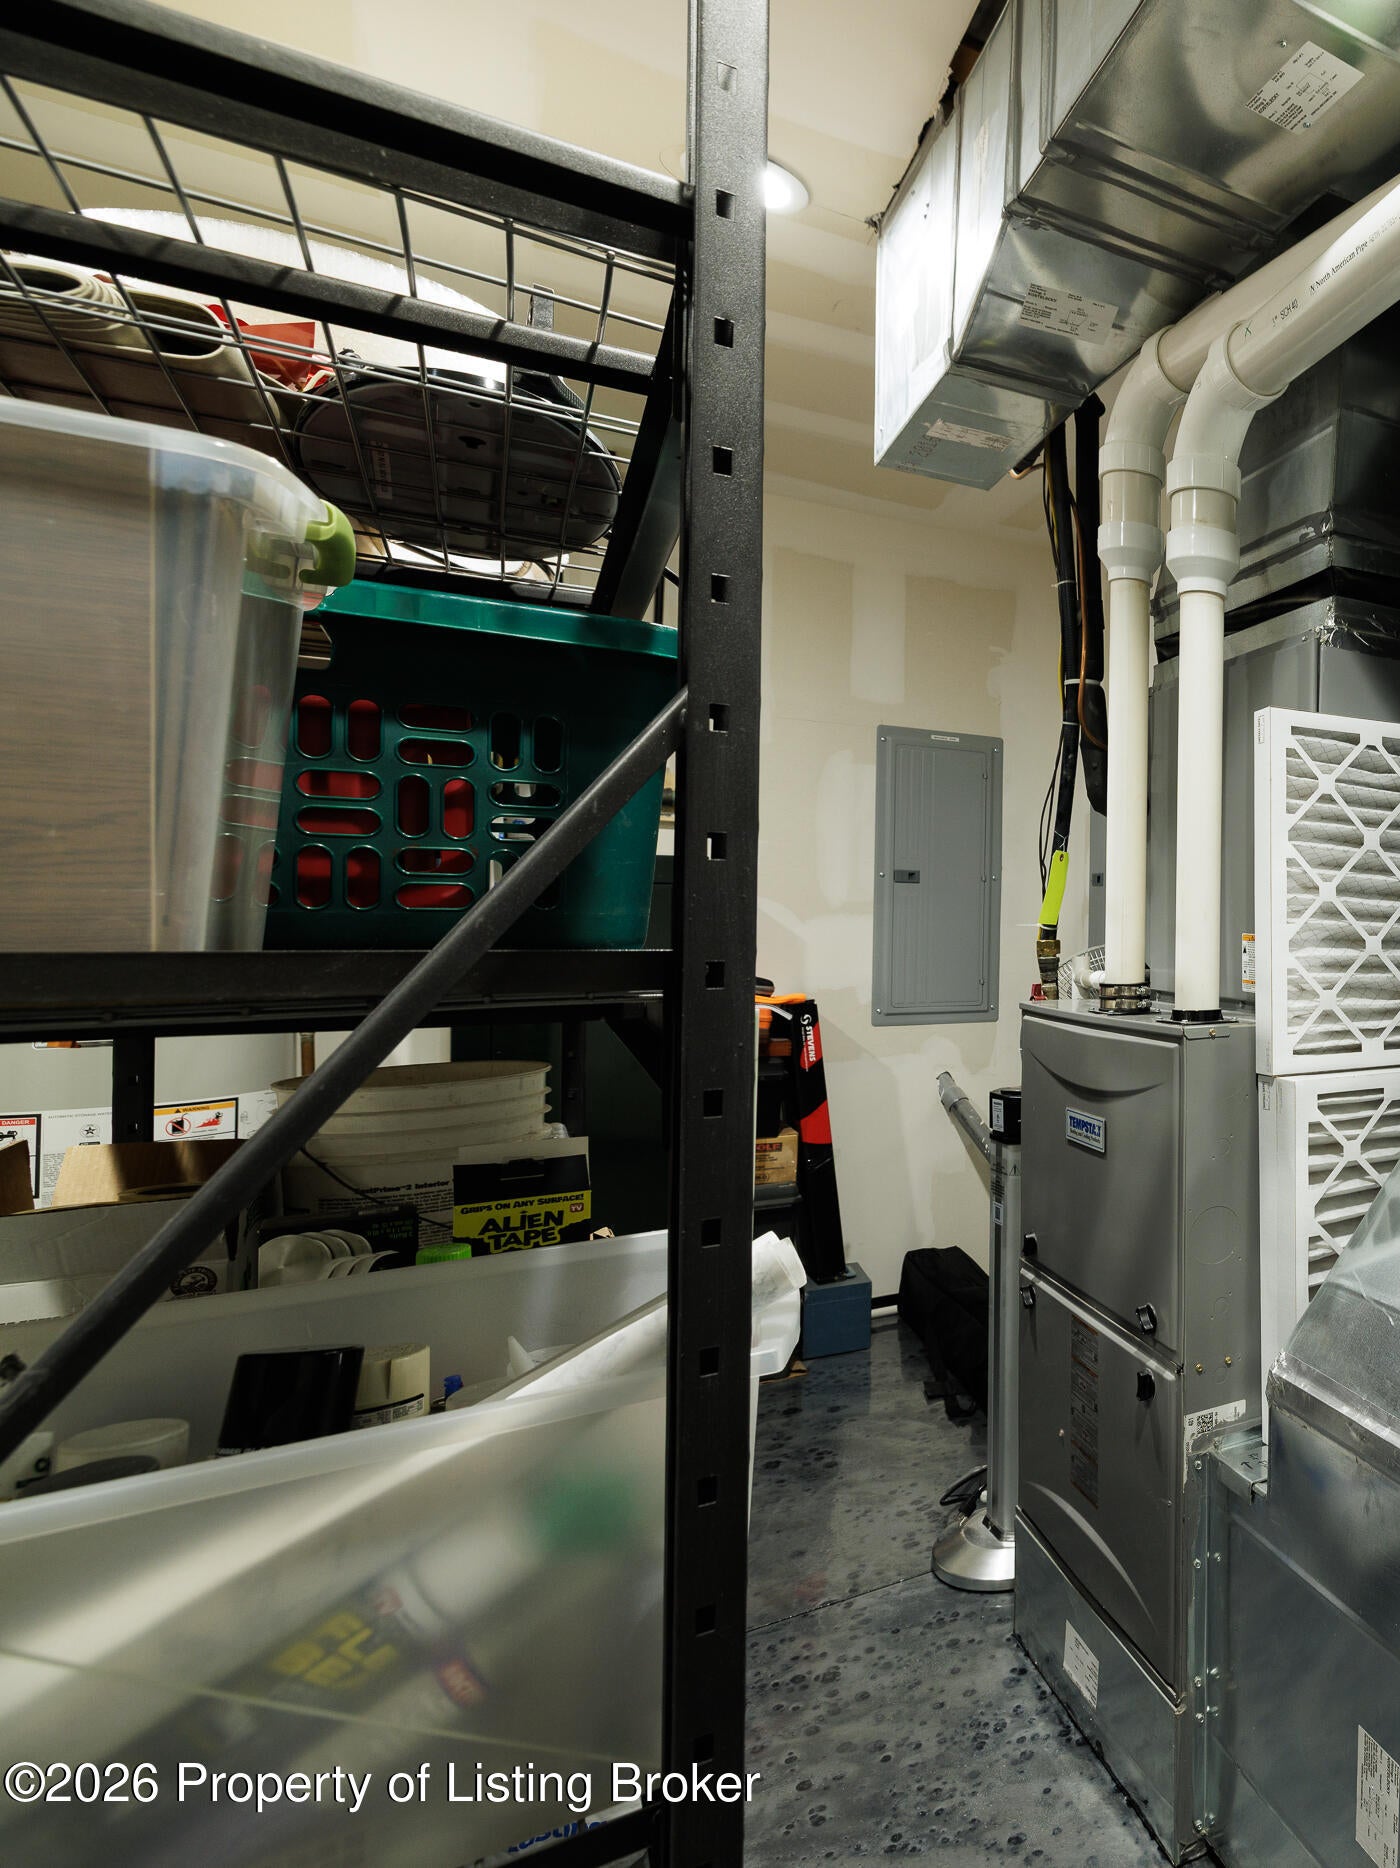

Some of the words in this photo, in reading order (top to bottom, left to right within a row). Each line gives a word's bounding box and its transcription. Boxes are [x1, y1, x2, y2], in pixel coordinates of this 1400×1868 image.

[1315, 273, 1331, 288] North
[1331, 251, 1356, 276] American
[1355, 240, 1368, 255] Pipe
[805, 1025, 816, 1062] STEVENS
[183, 1105, 210, 1113] WARNING
[461, 1203, 493, 1215] GRIPS
[495, 1202, 511, 1211] ON
[513, 1199, 535, 1208] ANY
[537, 1193, 585, 1206] SURFACE!
[486, 1228, 558, 1251] TAPE
